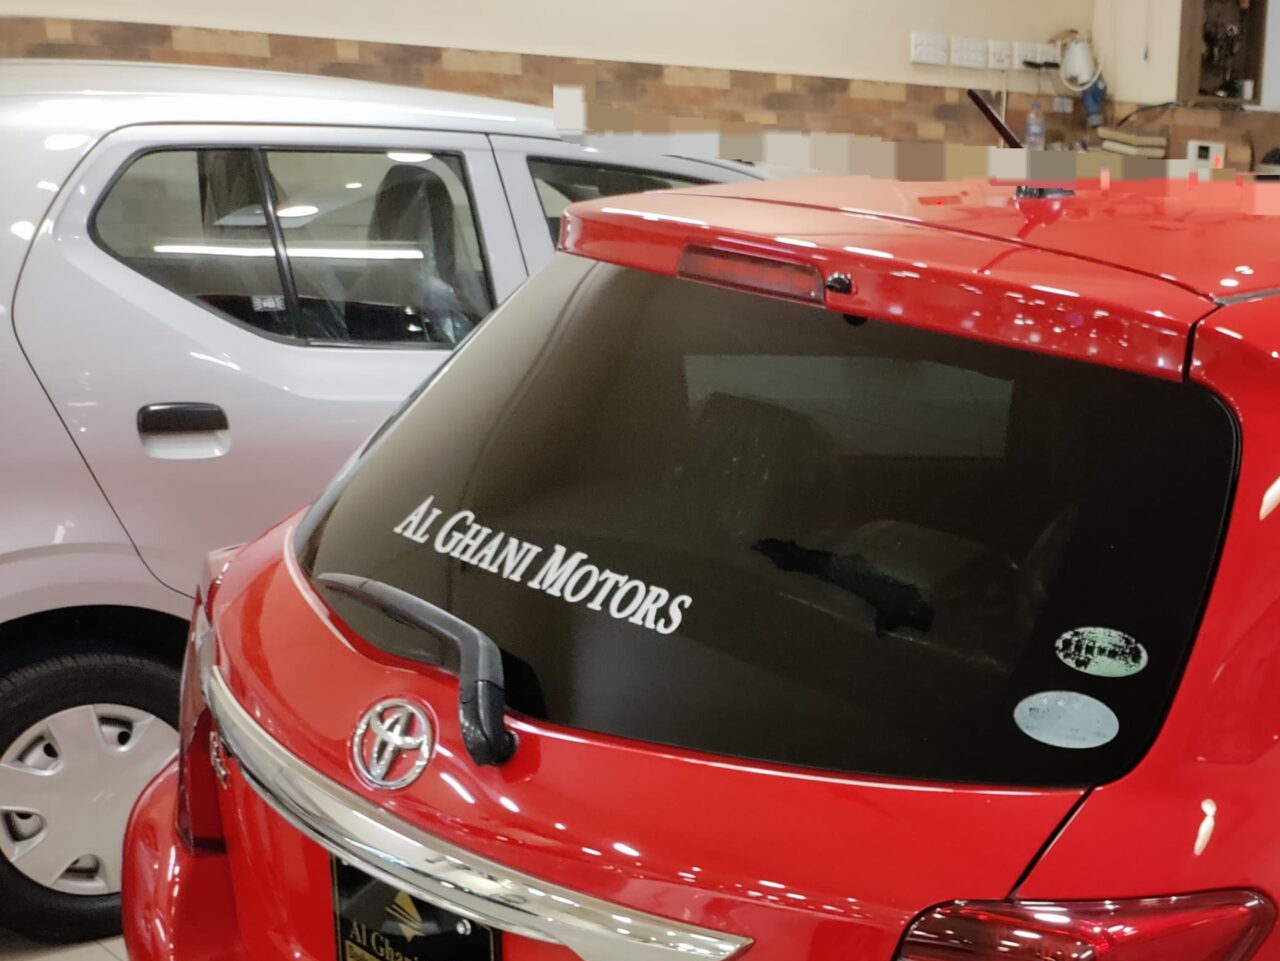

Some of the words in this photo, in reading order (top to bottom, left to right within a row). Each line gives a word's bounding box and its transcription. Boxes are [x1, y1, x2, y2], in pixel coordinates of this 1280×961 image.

[393, 495, 442, 544] AL
[433, 510, 543, 582] GHANI
[527, 544, 693, 635] MOTORS
[349, 919, 366, 947] Al
